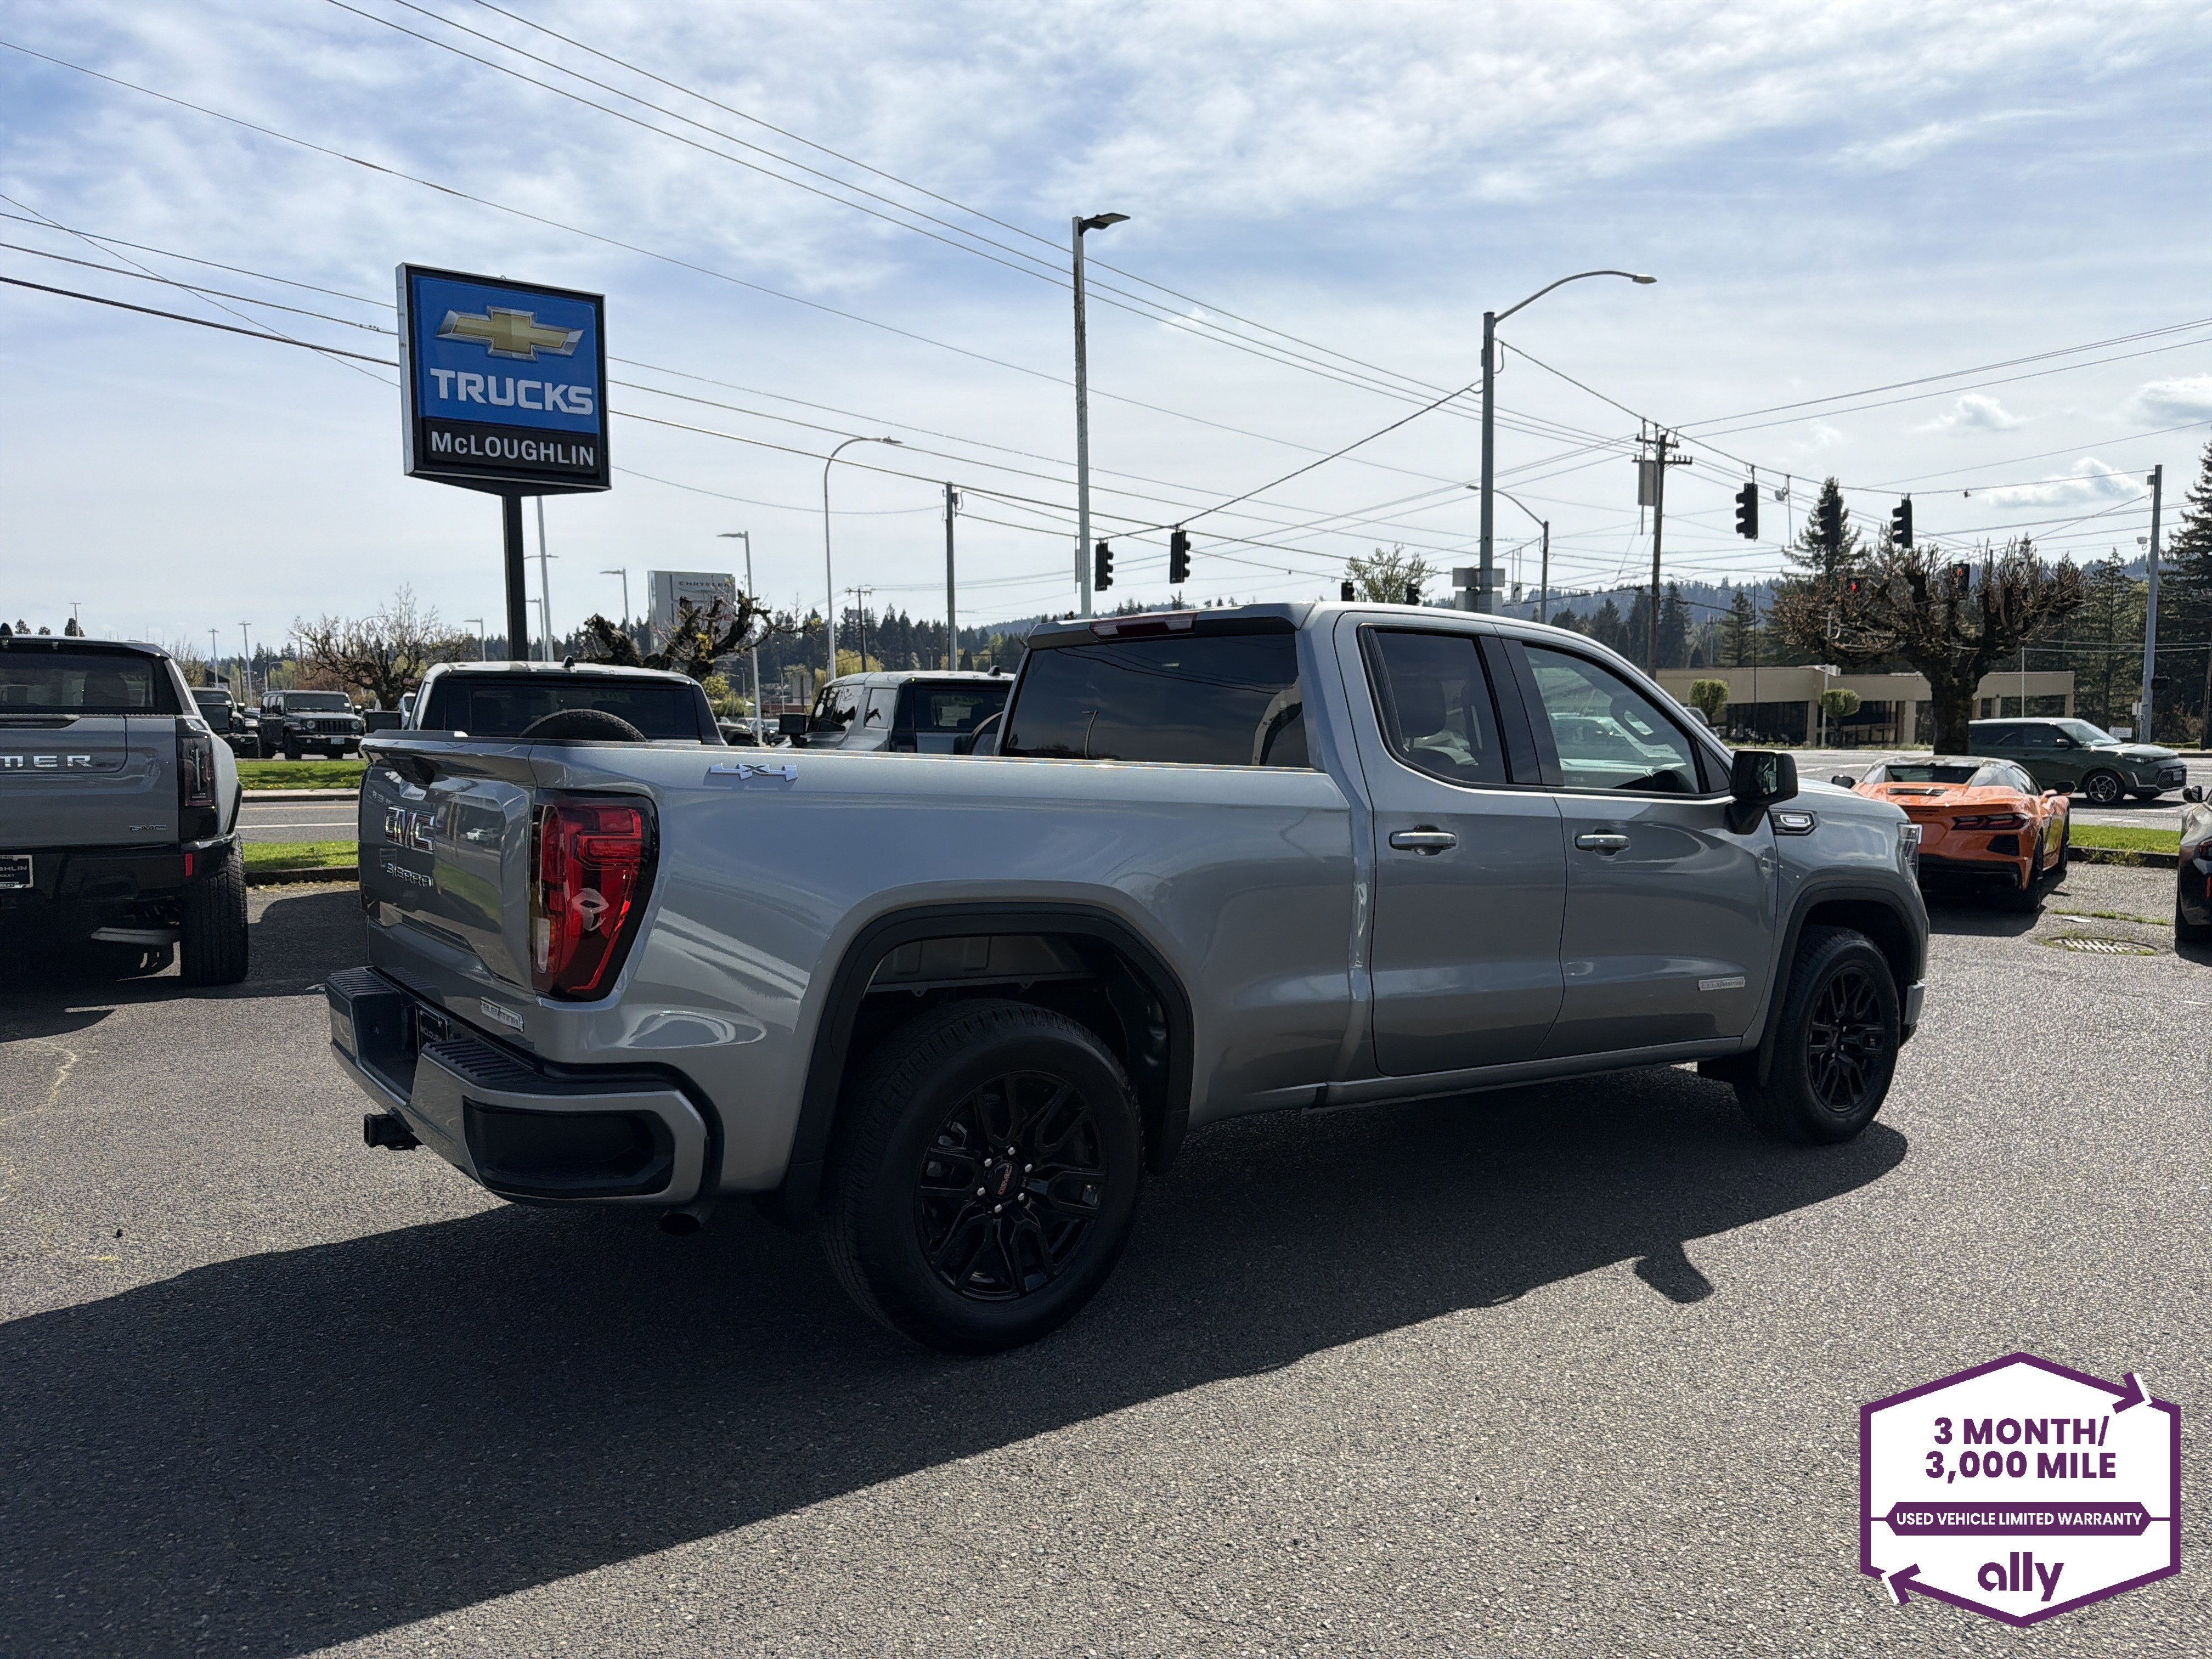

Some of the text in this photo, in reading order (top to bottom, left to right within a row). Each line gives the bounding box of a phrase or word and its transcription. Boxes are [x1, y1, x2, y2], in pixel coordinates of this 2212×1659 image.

[430, 368, 594, 415] TRUCKS
[431, 431, 594, 466] McLOUGHLIN
[385, 805, 436, 855] GMC
[386, 862, 433, 887] SIERRA
